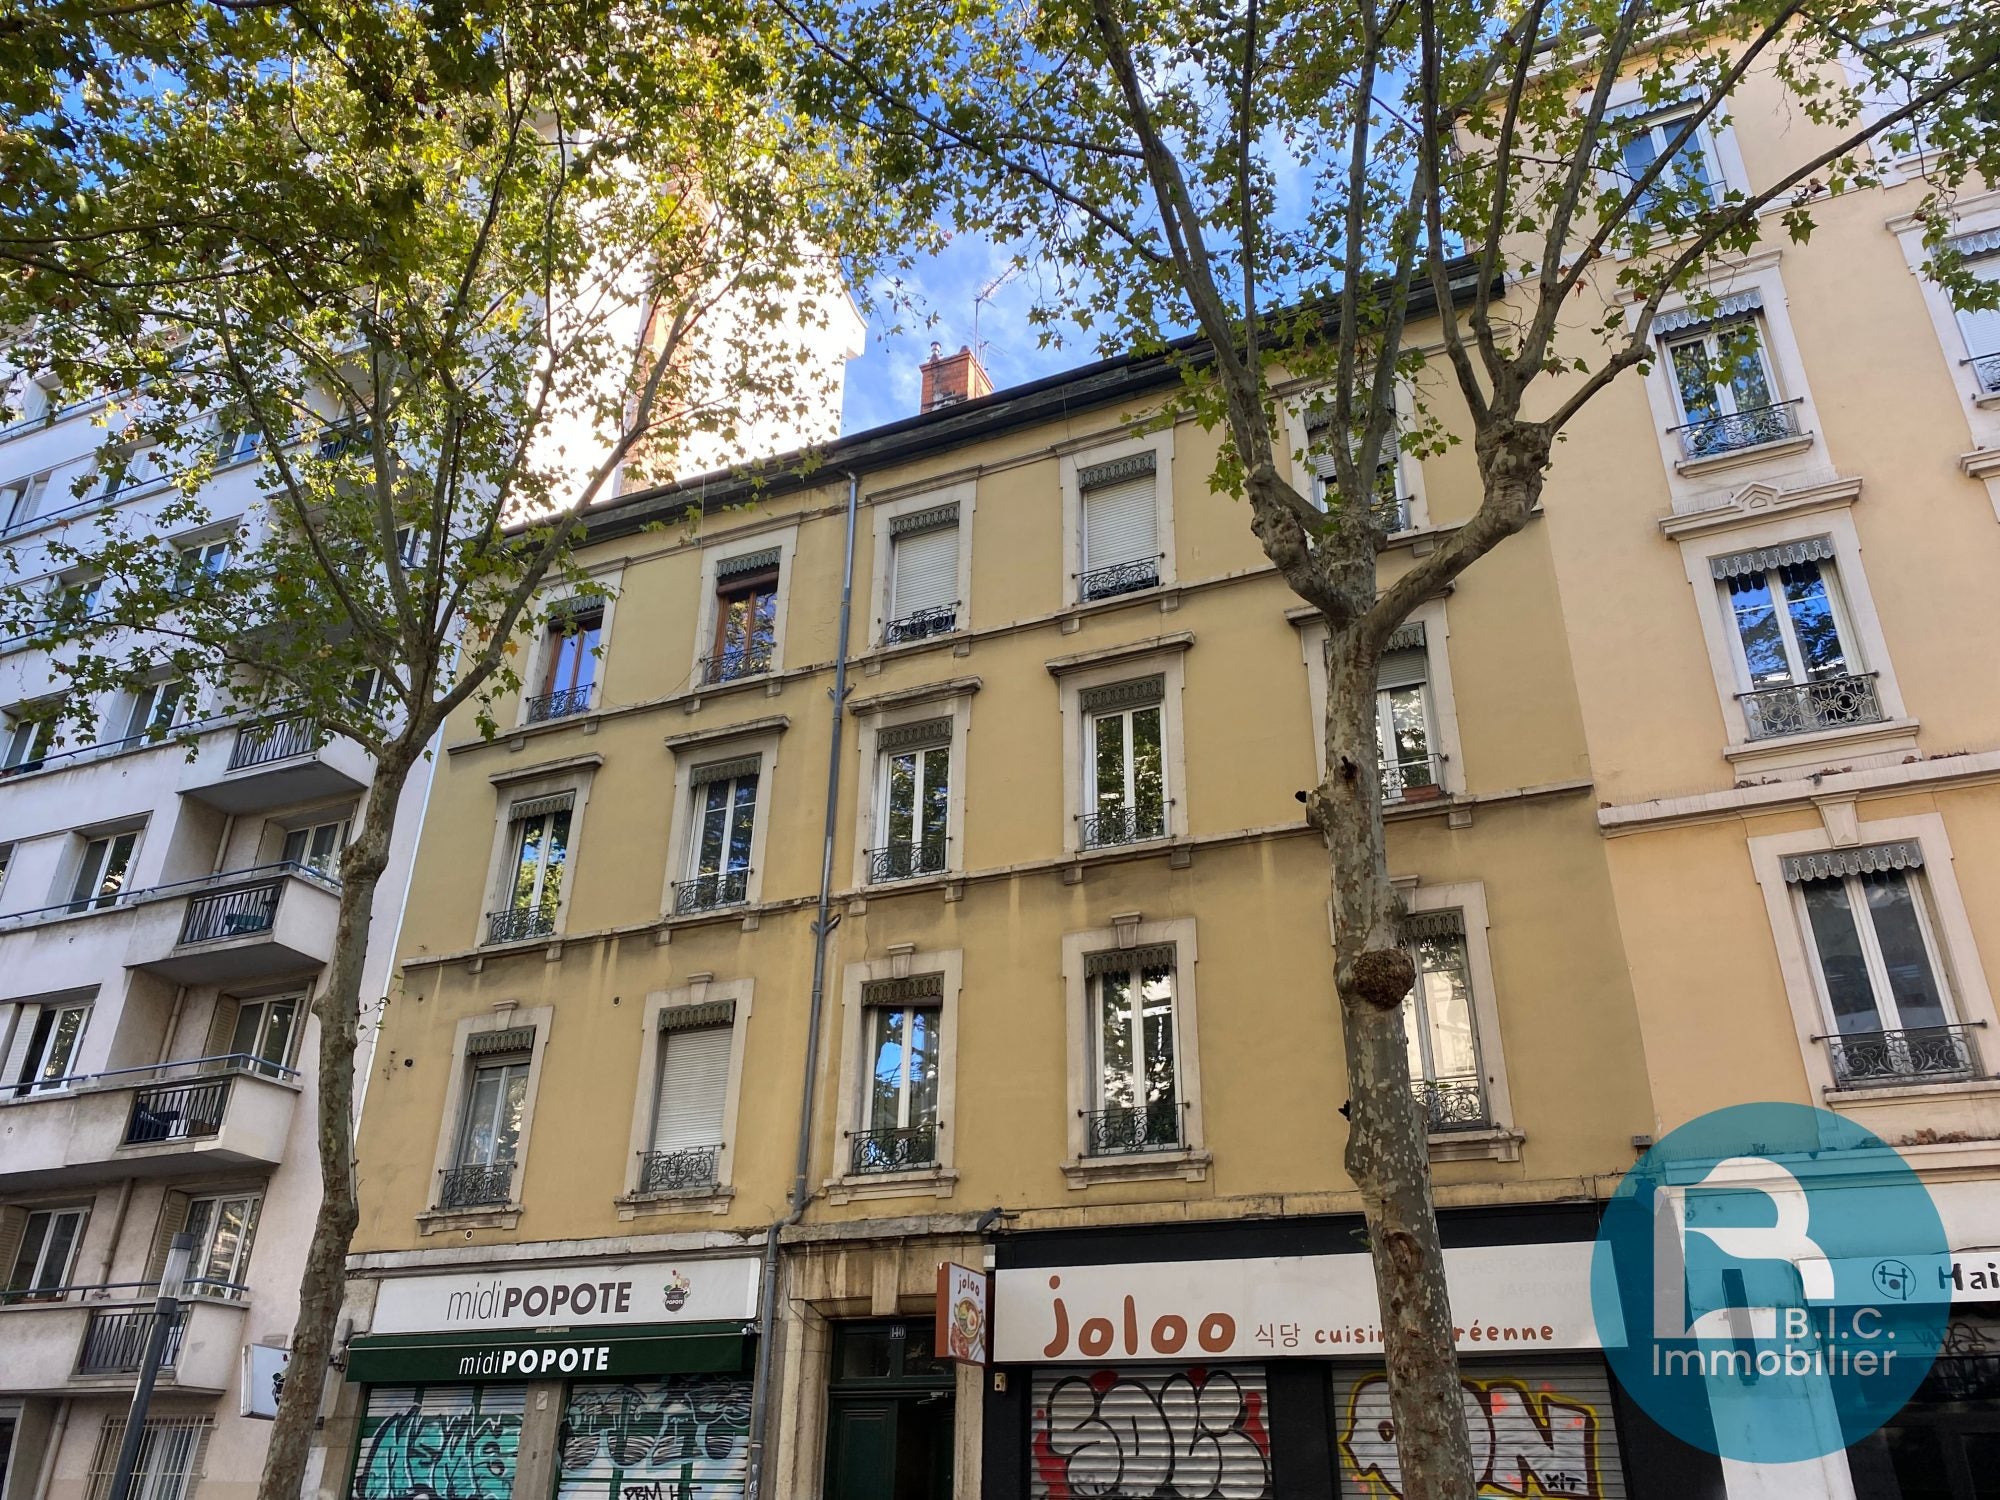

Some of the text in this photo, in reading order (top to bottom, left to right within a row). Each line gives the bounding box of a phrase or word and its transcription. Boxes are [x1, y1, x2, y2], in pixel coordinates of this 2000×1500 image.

[957, 1273, 980, 1297] joloo
[1938, 1262, 2000, 1291] Hai
[1043, 1275, 1236, 1358] joloo
[890, 1325, 905, 1338] 140
[1255, 1322, 1301, 1349] 식당
[1453, 1319, 1554, 1342] réenne
